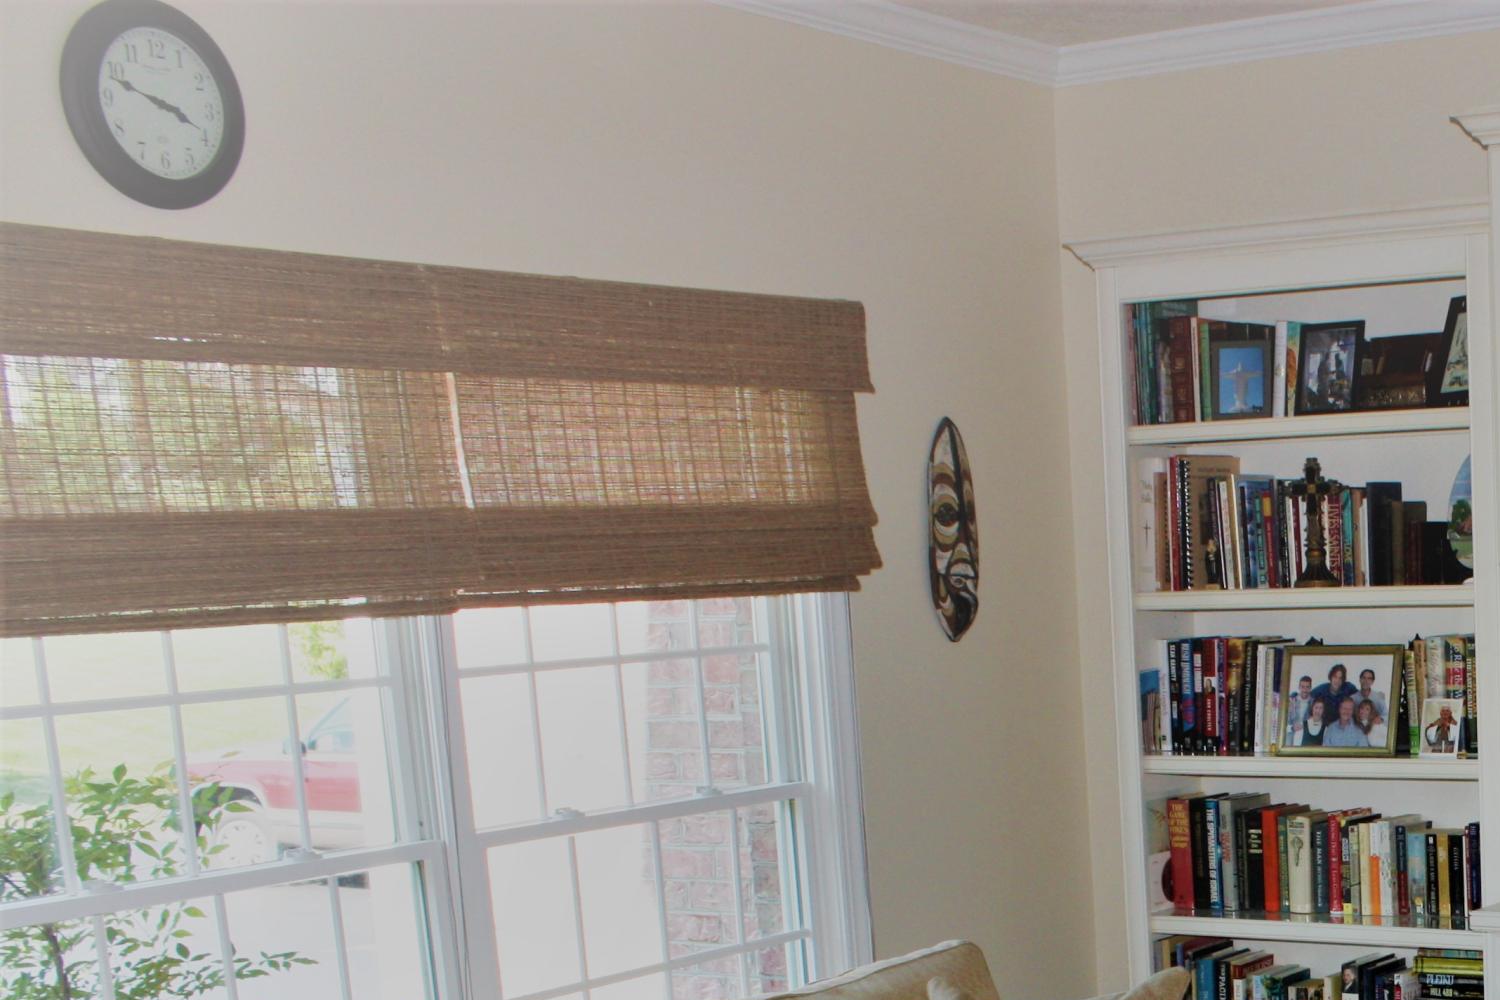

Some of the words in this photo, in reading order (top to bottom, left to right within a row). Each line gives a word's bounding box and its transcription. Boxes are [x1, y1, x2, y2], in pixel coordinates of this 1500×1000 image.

[124, 43, 139, 64] 11
[146, 39, 166, 60] 12
[175, 49, 185, 69] 1
[107, 61, 125, 80] 10
[193, 73, 205, 92] 2
[102, 89, 114, 107] 9
[204, 103, 215, 122] 3
[112, 119, 126, 137] 8
[136, 141, 146, 161] 7
[160, 152, 171, 169] 6
[184, 147, 195, 166] 5
[1327, 503, 1341, 529] LIVES
[1328, 535, 1341, 568] SAINTS
[1206, 808, 1215, 822] THE
[1430, 987, 1442, 997] HILL
